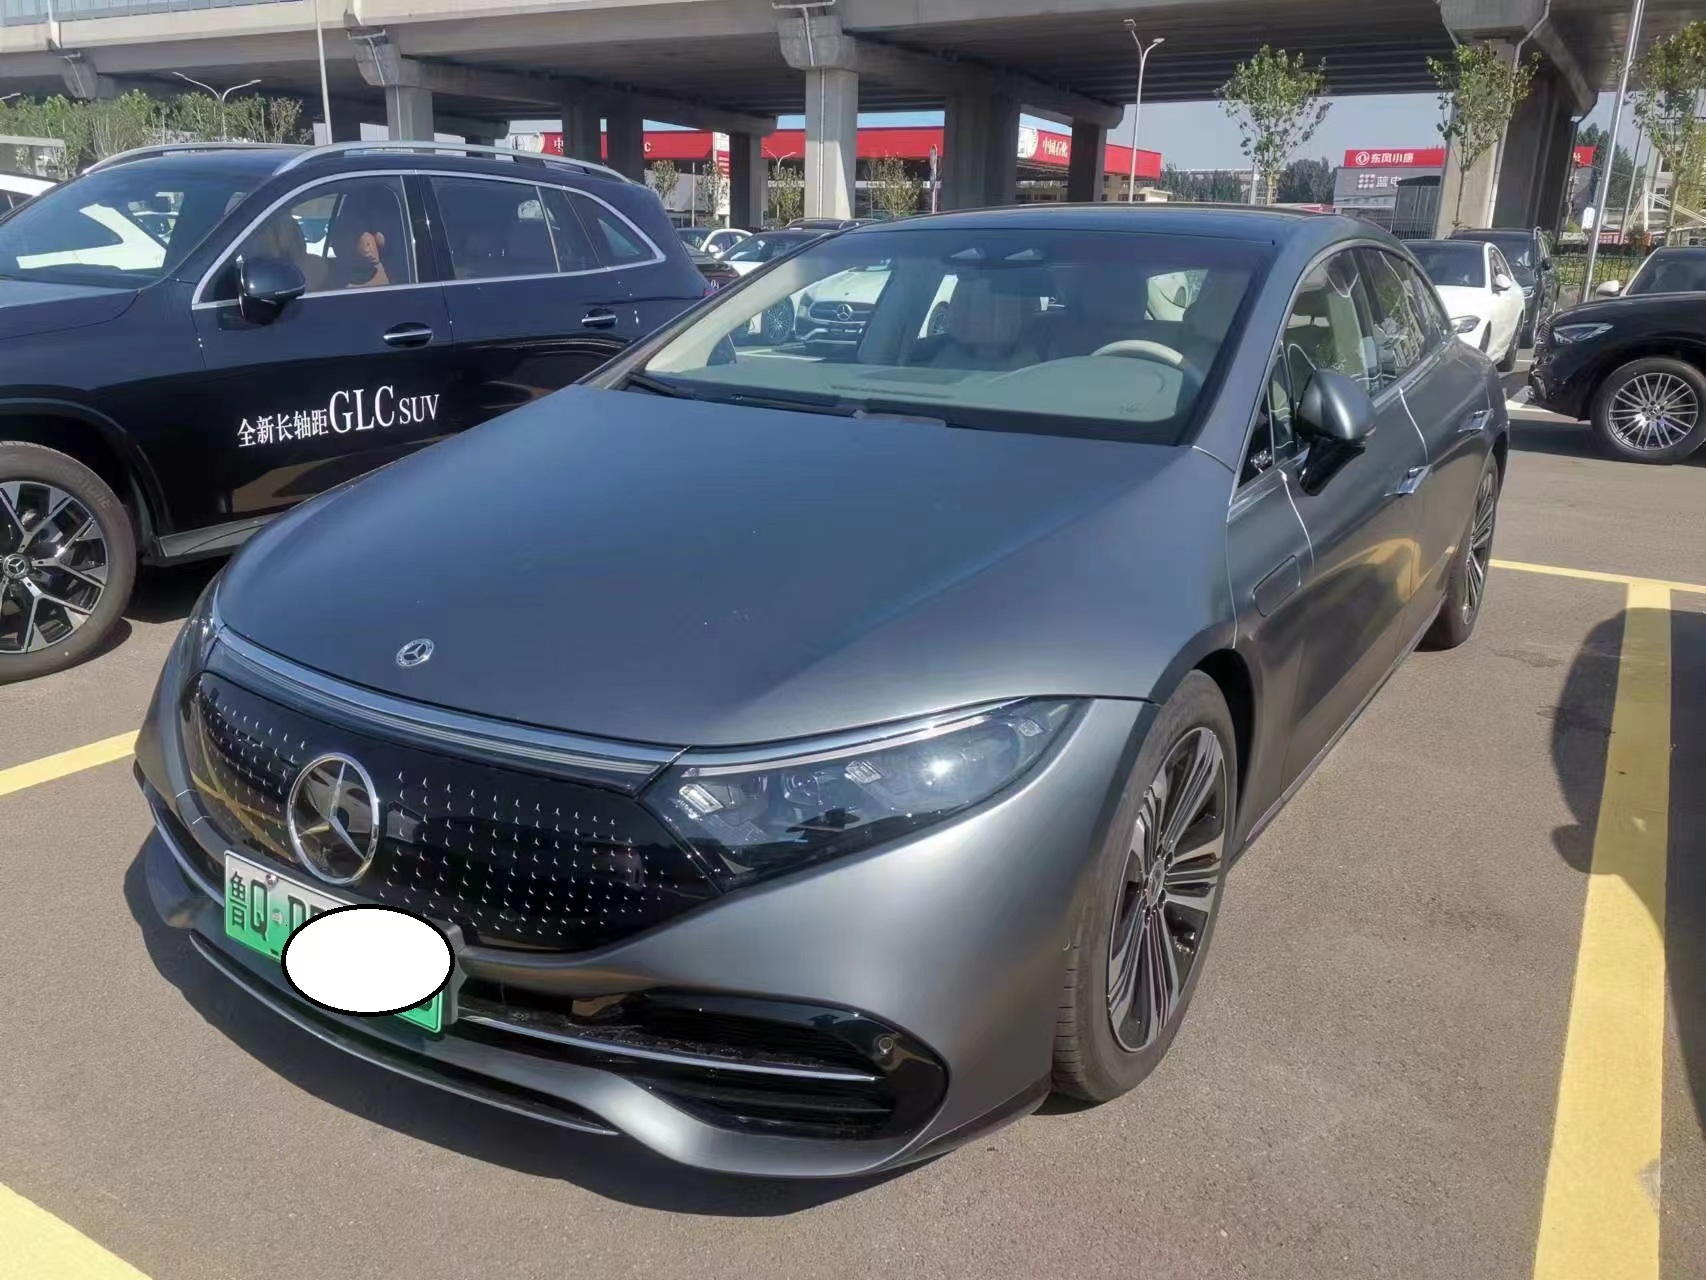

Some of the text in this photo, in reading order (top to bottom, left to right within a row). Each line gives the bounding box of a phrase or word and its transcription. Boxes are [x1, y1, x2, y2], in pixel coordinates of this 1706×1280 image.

[1370, 152, 1415, 164] 东风小康
[237, 407, 328, 447] 全新长轴距
[329, 384, 440, 434] GLC SUV
